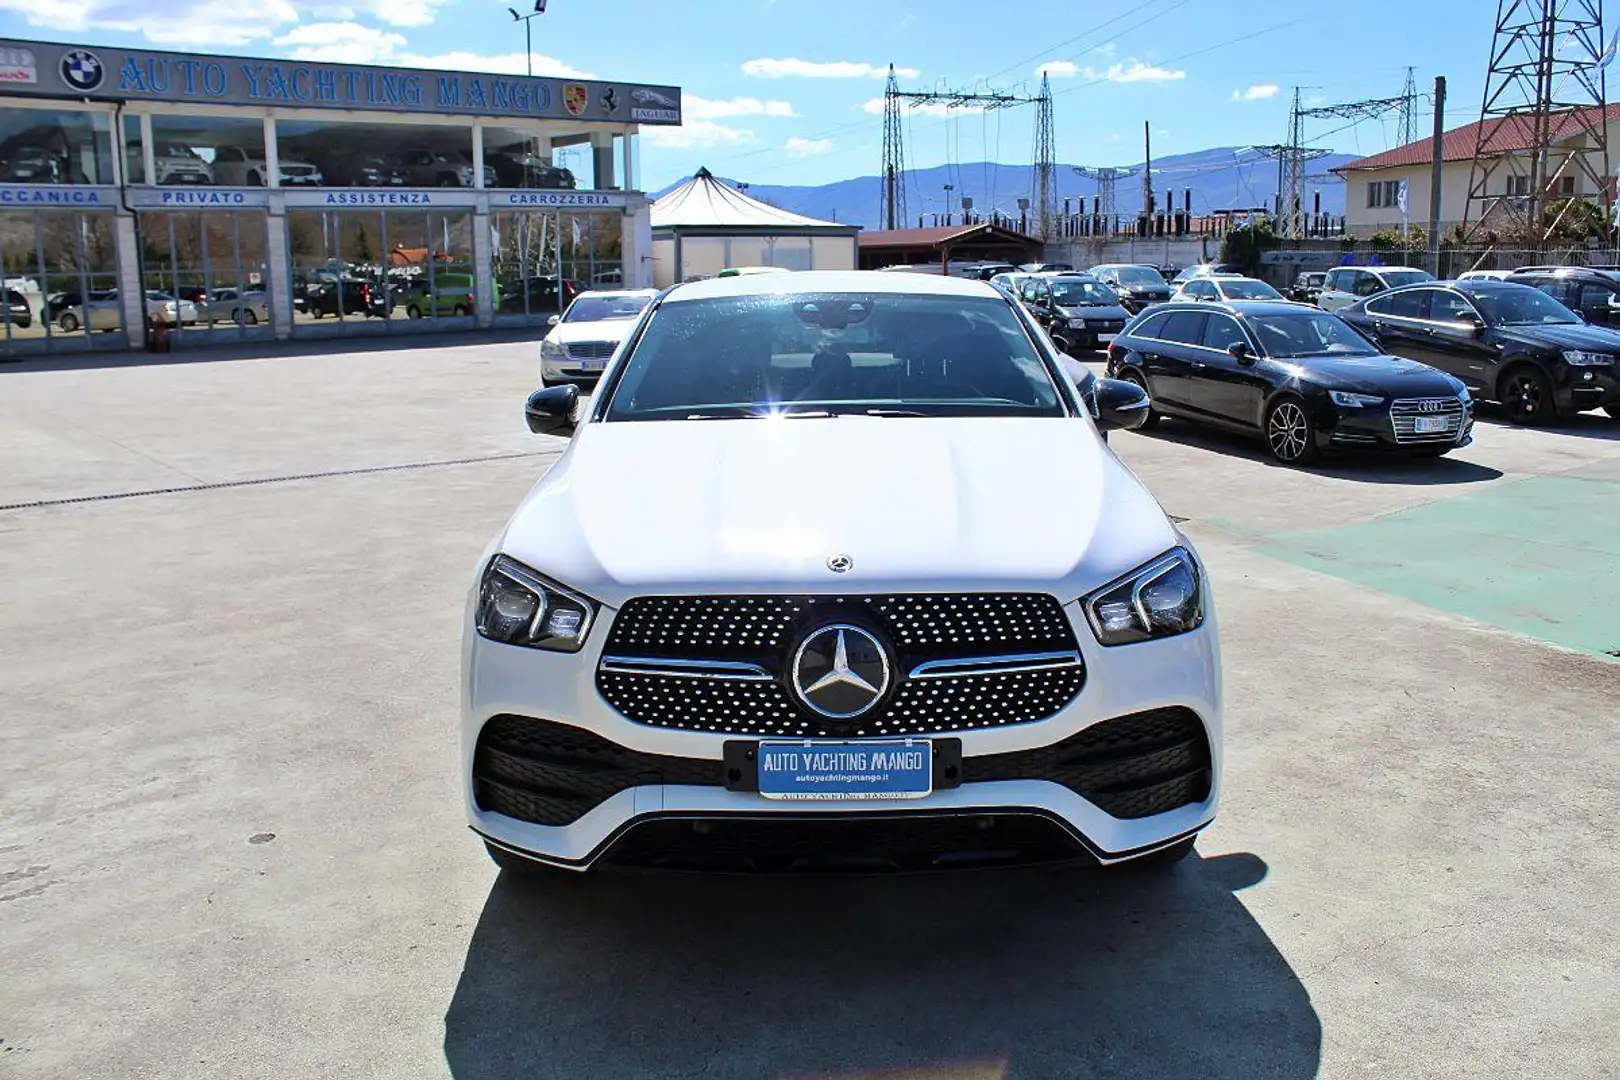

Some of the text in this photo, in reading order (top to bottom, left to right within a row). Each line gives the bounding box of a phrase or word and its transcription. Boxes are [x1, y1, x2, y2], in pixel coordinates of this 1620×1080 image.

[117, 56, 551, 111] AUTO YACHTING MANGO
[635, 108, 678, 120] JAGUAR
[1, 190, 98, 203] CCANICA
[162, 192, 244, 204] PRIVATO
[327, 193, 431, 204] ASSISTENZA
[510, 194, 609, 205] CARROZZERIA
[764, 751, 922, 771] AUTO YACHTING MANGO
[795, 773, 889, 783] autoyachtingmango.it
